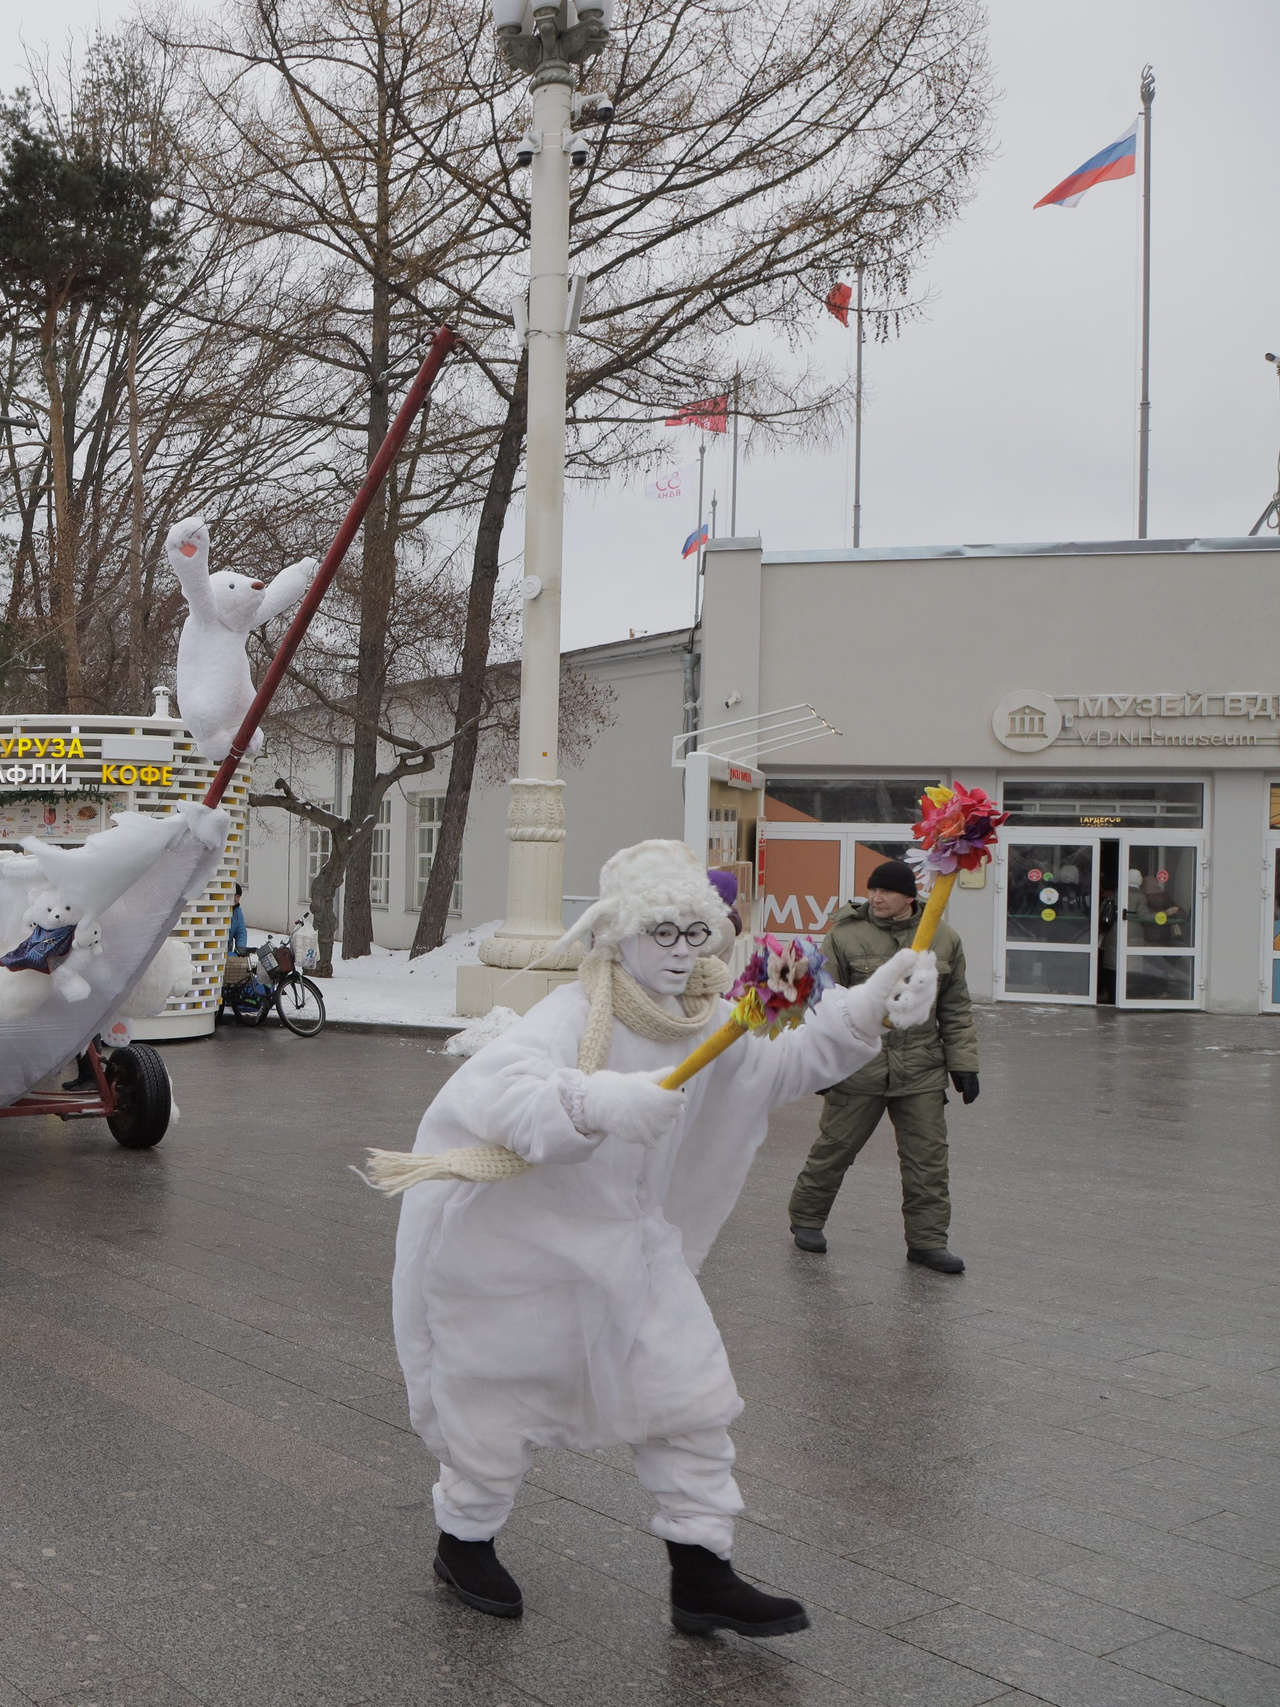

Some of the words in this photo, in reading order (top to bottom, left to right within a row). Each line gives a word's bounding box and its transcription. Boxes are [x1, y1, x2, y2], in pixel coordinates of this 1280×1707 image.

[1078, 690, 1208, 717] МУЗЕЙ
[1224, 695, 1280, 720] ВД
[1077, 728, 1155, 746] VDNH
[1165, 733, 1258, 746] museum
[102, 764, 173, 786] КОФЕ
